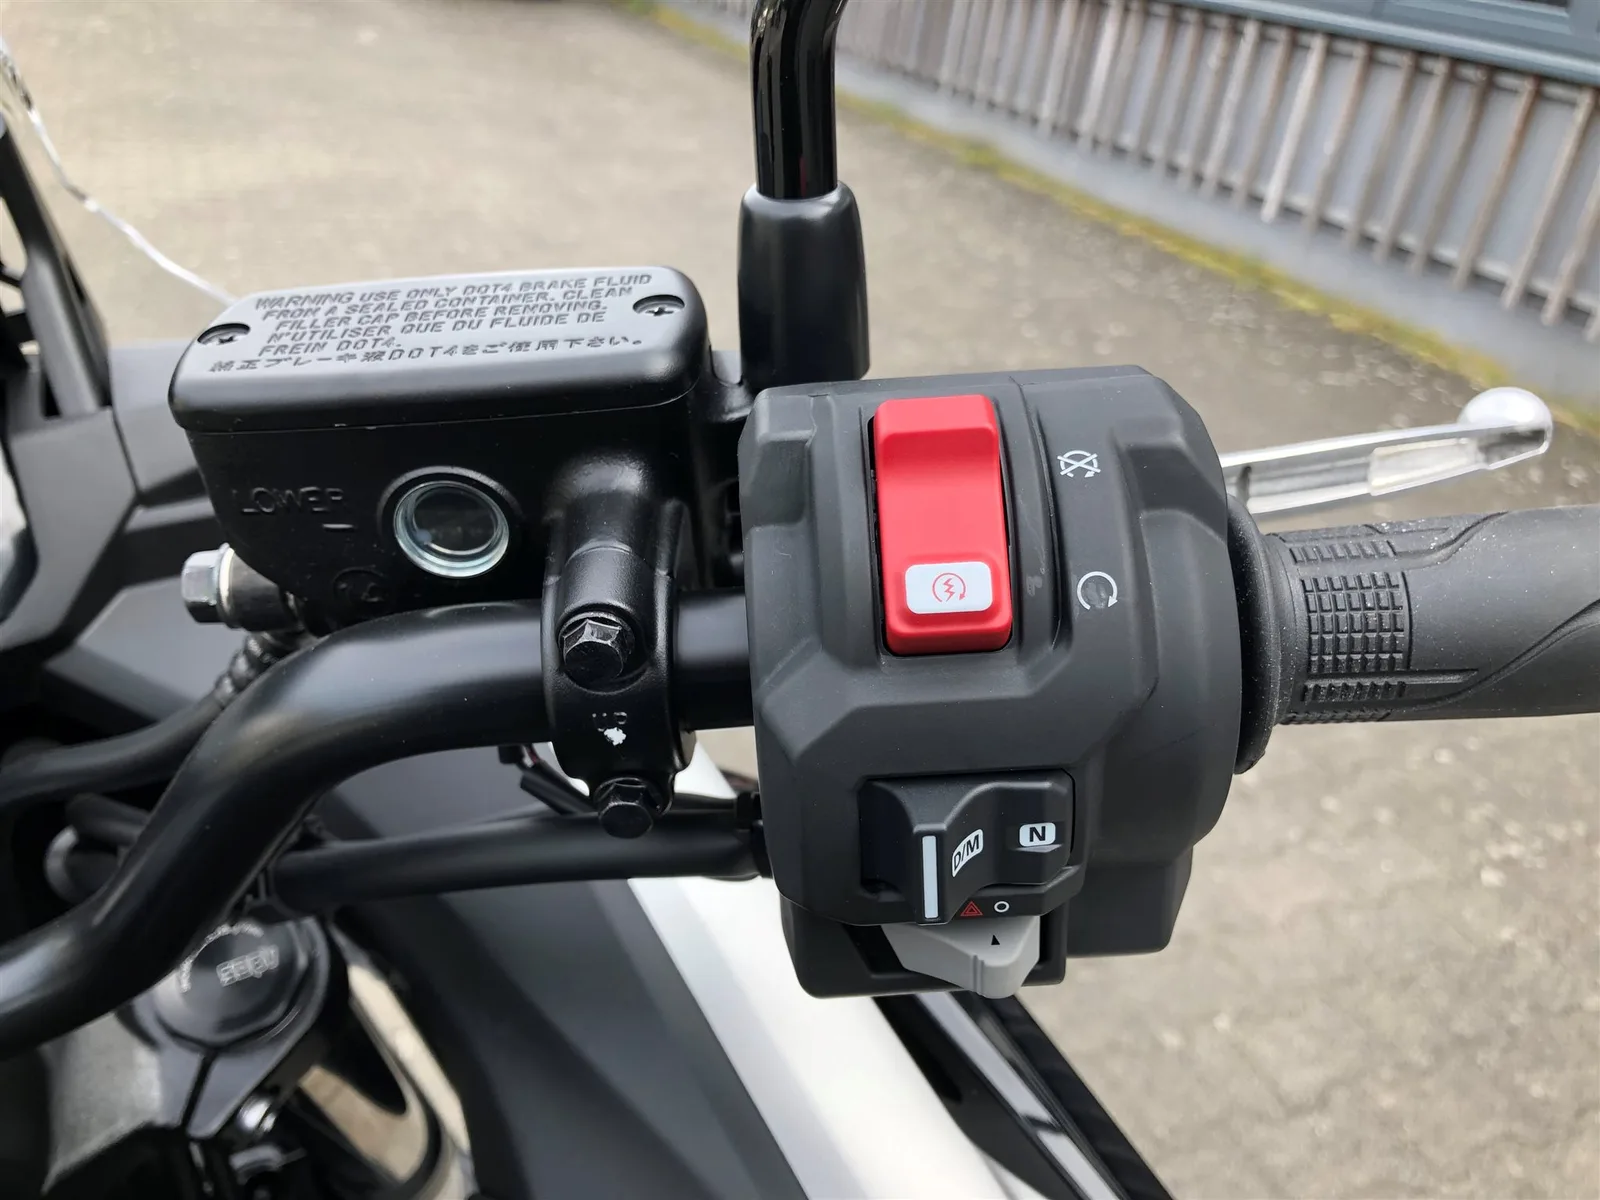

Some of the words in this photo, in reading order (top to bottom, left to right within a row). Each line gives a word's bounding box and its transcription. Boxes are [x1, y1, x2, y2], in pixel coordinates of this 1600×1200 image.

[256, 291, 355, 309] WARNING
[359, 289, 401, 301] USE
[406, 286, 458, 299] ONLY
[463, 283, 513, 296] DOT4
[519, 278, 587, 292] BRAKE
[593, 274, 652, 287] FLUID
[262, 306, 321, 321] FROM
[325, 305, 338, 317] A
[344, 300, 428, 315] SEALED
[434, 292, 555, 308] CONTAINER.
[558, 287, 632, 300] CLEAN
[267, 325, 392, 343] N'UTILISER
[400, 322, 445, 334] QUE
[452, 319, 483, 331] DU
[489, 313, 569, 329] FLUIDE
[577, 311, 606, 323] DE
[275, 316, 355, 331] FILLER
[357, 313, 399, 325] CAP
[404, 305, 488, 322] BEFORE
[493, 300, 608, 316] REMOVING.
[258, 342, 327, 357] FREIN
[336, 337, 402, 351] DOT4.
[232, 486, 346, 514] LOWER
[1029, 826, 1047, 842] N
[953, 835, 981, 870] D/M
